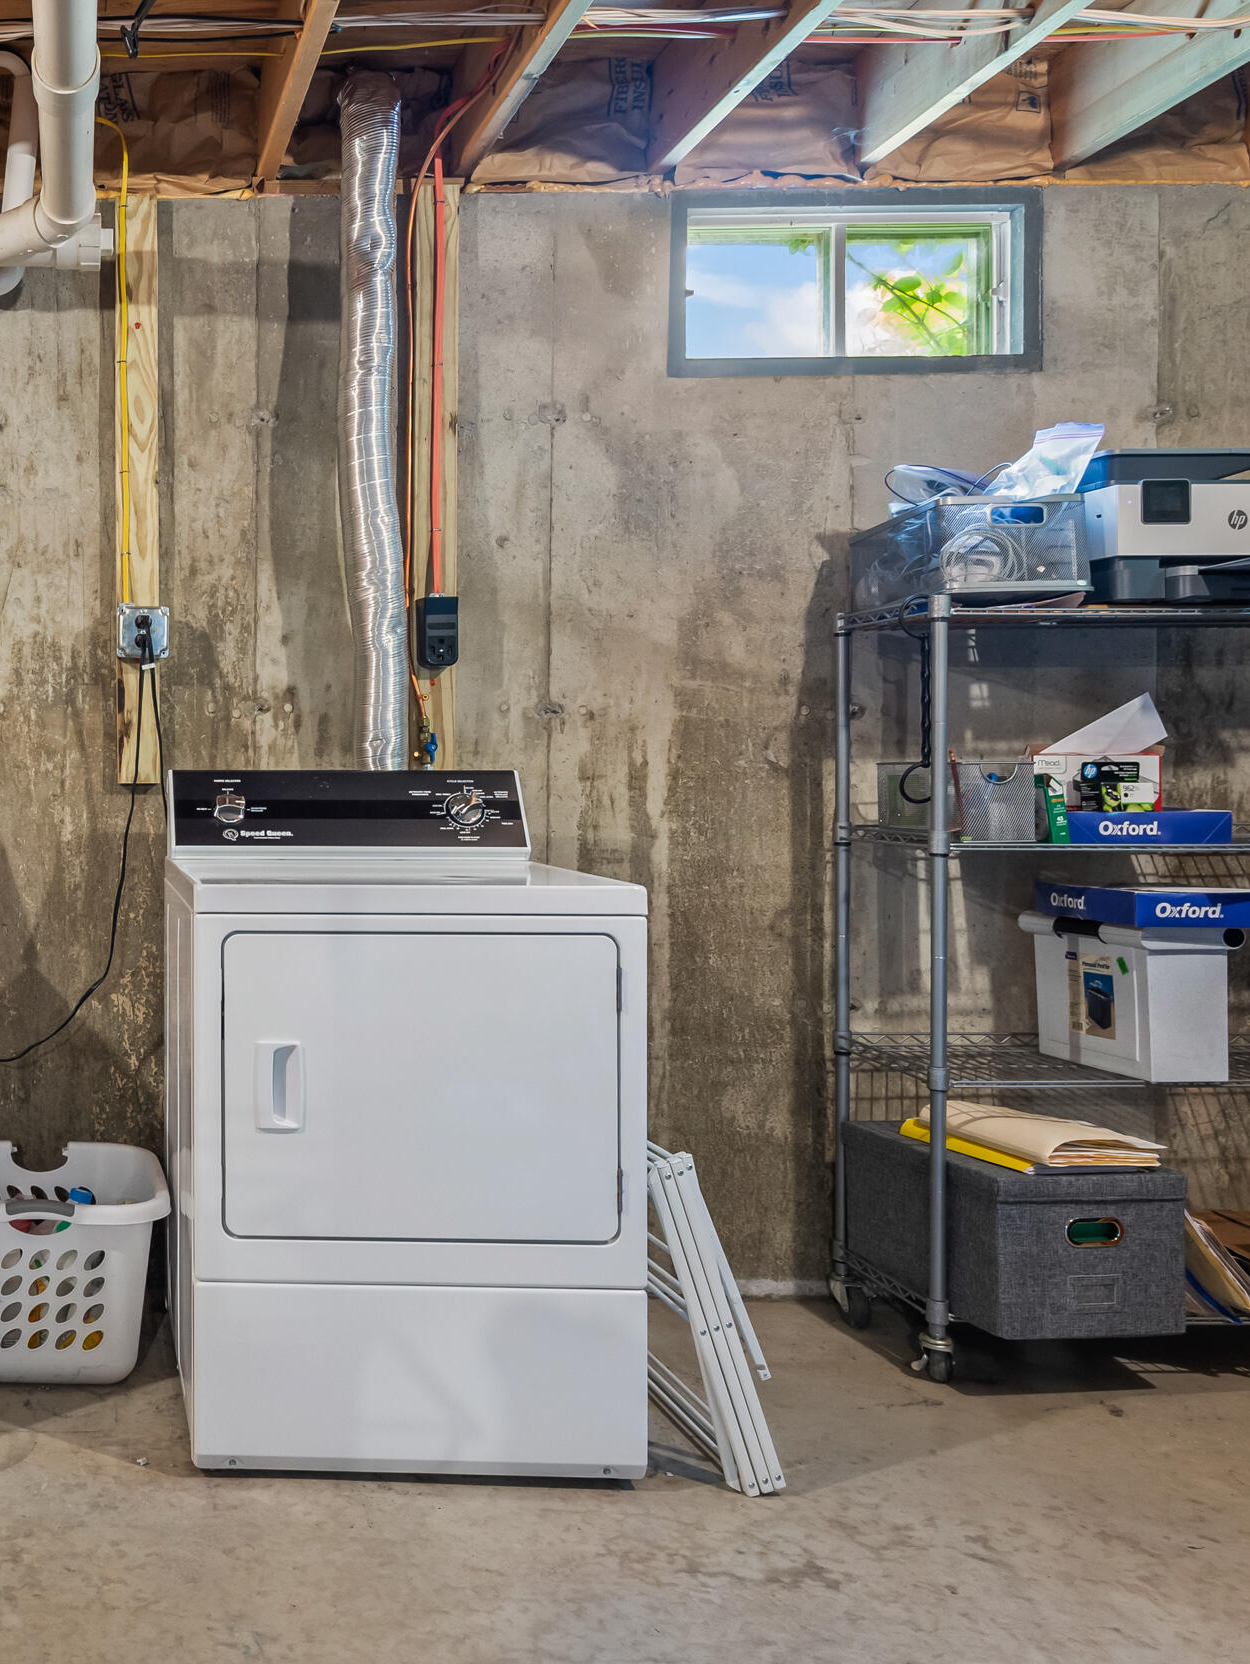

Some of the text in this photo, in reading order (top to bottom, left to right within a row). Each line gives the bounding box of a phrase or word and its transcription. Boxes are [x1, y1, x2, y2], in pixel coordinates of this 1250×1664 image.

[1230, 509, 1247, 530] hp
[1084, 764, 1097, 778] hp
[240, 829, 265, 838] Speed
